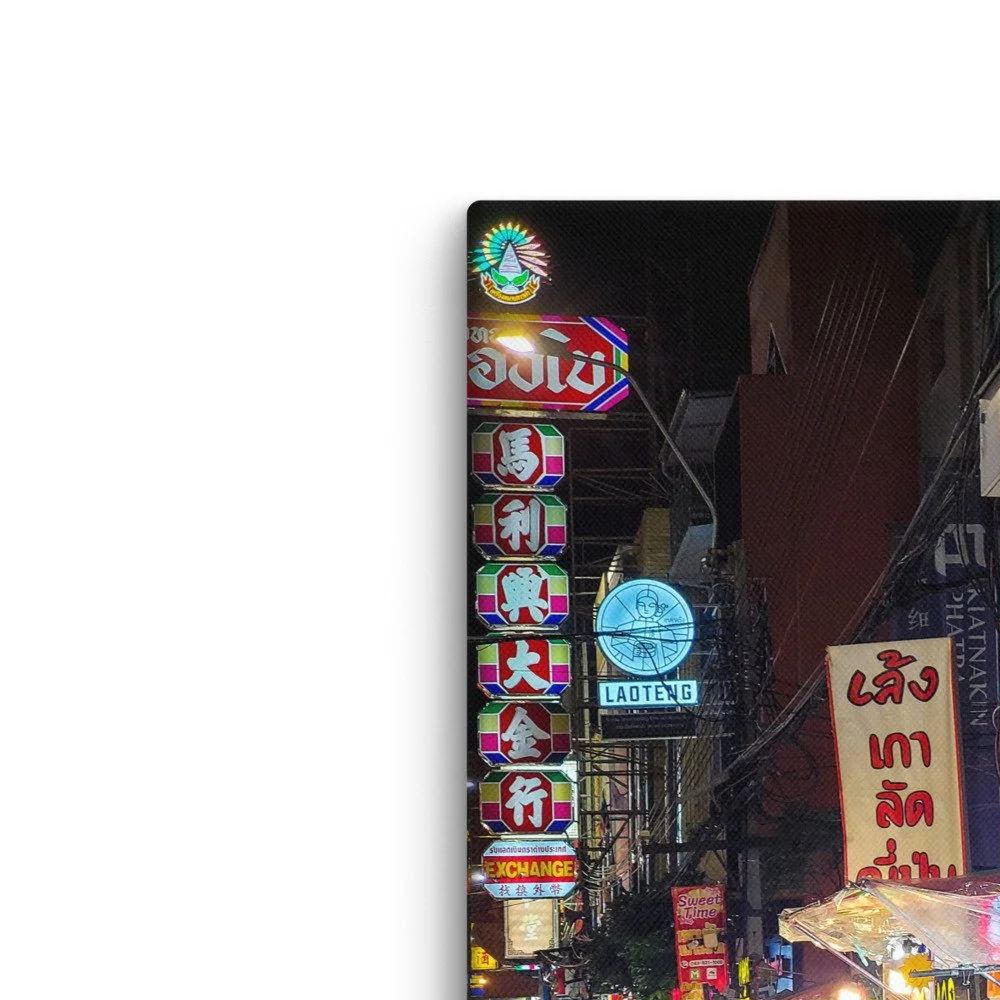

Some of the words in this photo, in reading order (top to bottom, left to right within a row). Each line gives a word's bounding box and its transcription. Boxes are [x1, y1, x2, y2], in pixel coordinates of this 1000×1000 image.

[846, 649, 940, 707] เล้ง
[605, 683, 692, 703] LAOTENG
[869, 730, 931, 771] เกา
[875, 779, 934, 829] ลัด
[485, 860, 574, 879] EXCHANGE
[678, 894, 722, 908] Sweet
[683, 906, 718, 919] Time
